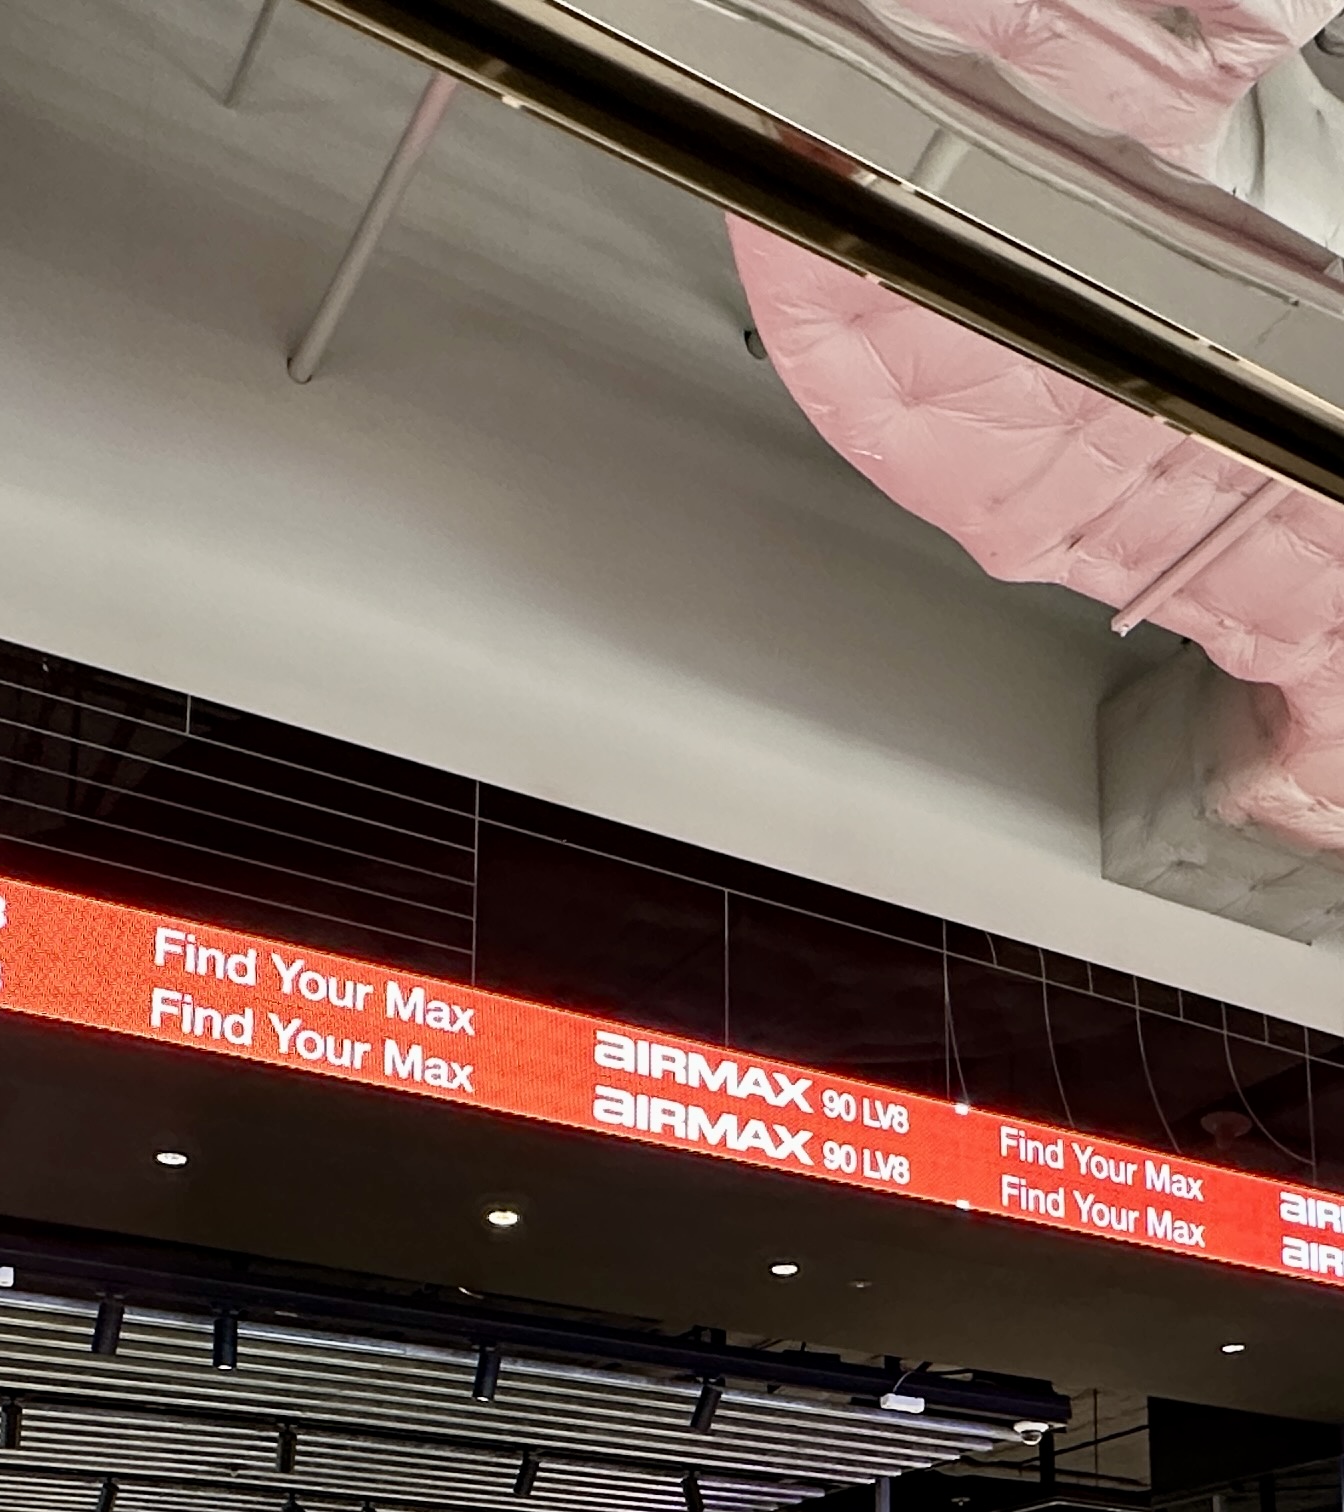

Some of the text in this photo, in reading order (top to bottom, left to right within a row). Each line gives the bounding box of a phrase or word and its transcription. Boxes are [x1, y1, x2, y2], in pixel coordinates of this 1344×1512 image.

[153, 925, 476, 1037] Find Your Max
[150, 987, 476, 1094] Find Your Max
[821, 1089, 857, 1122] 90
[862, 1097, 910, 1134] LV8
[822, 1140, 858, 1174] 90
[862, 1148, 911, 1185] LV8
[1000, 1125, 1204, 1202] Find Your Max
[1001, 1174, 1206, 1248] Find Your Max
